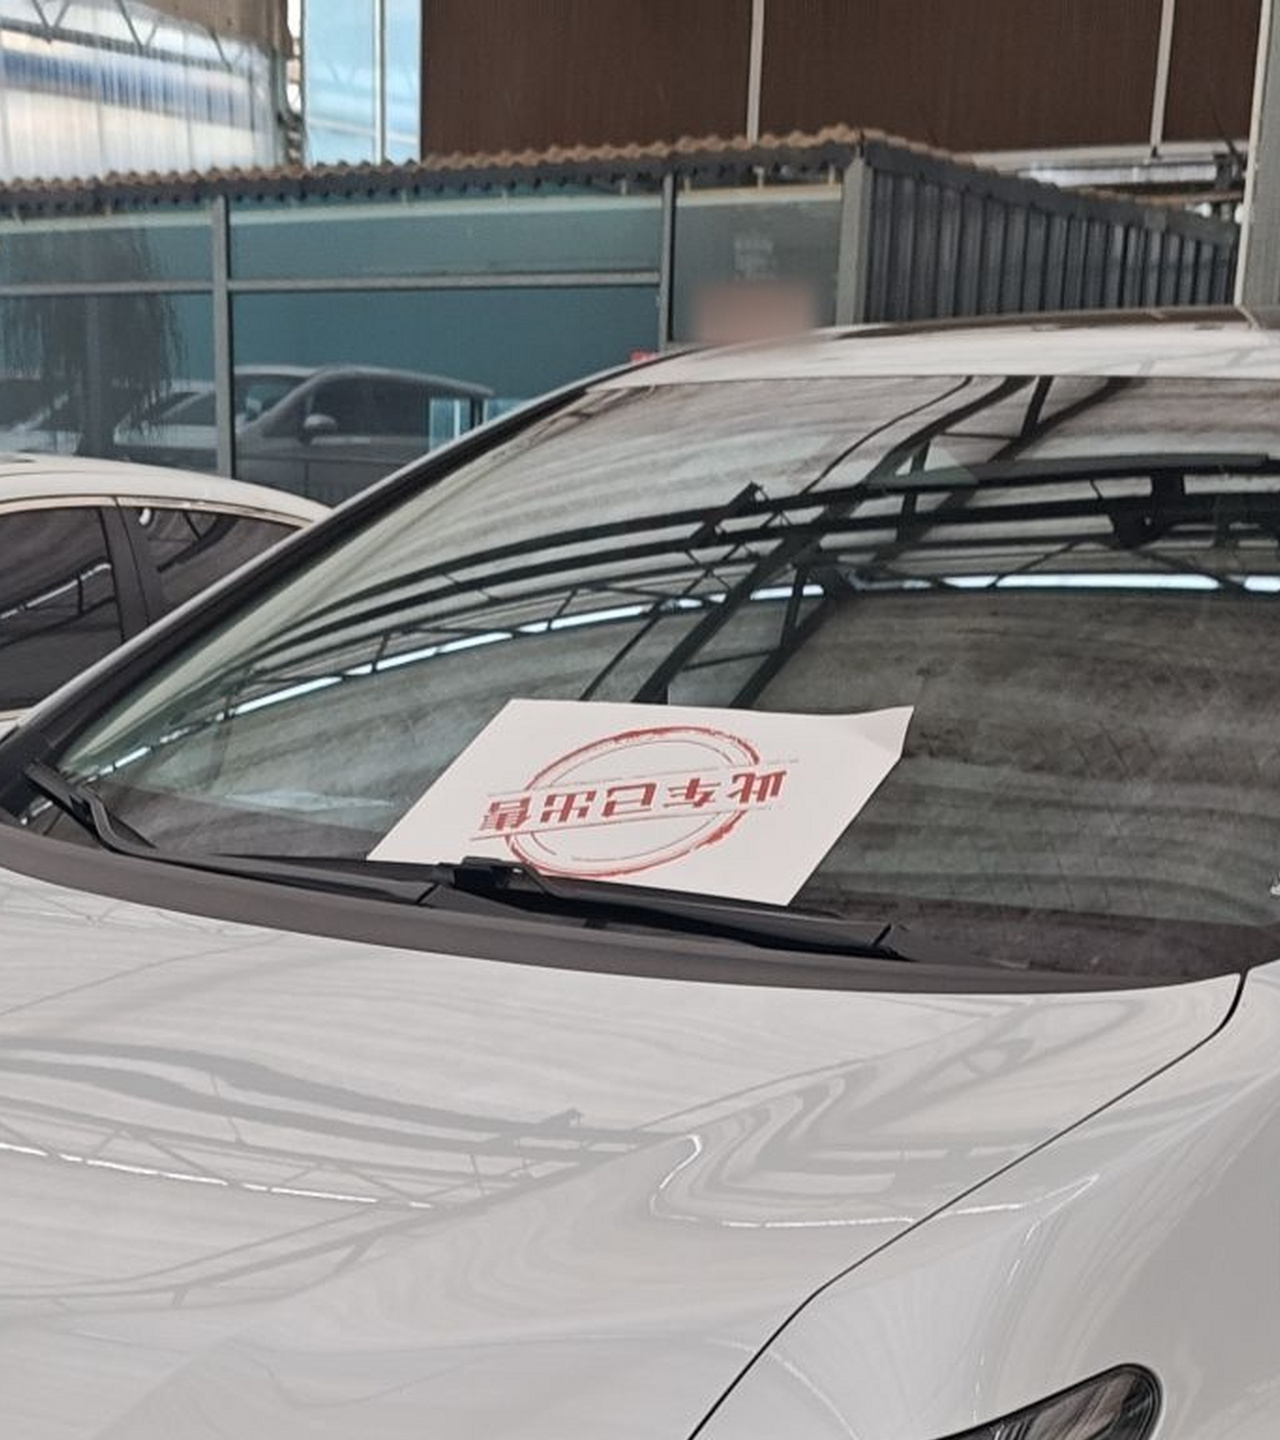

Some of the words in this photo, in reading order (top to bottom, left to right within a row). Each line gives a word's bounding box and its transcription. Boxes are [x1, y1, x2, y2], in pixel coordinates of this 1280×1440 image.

[479, 770, 788, 832] 此车已出售
